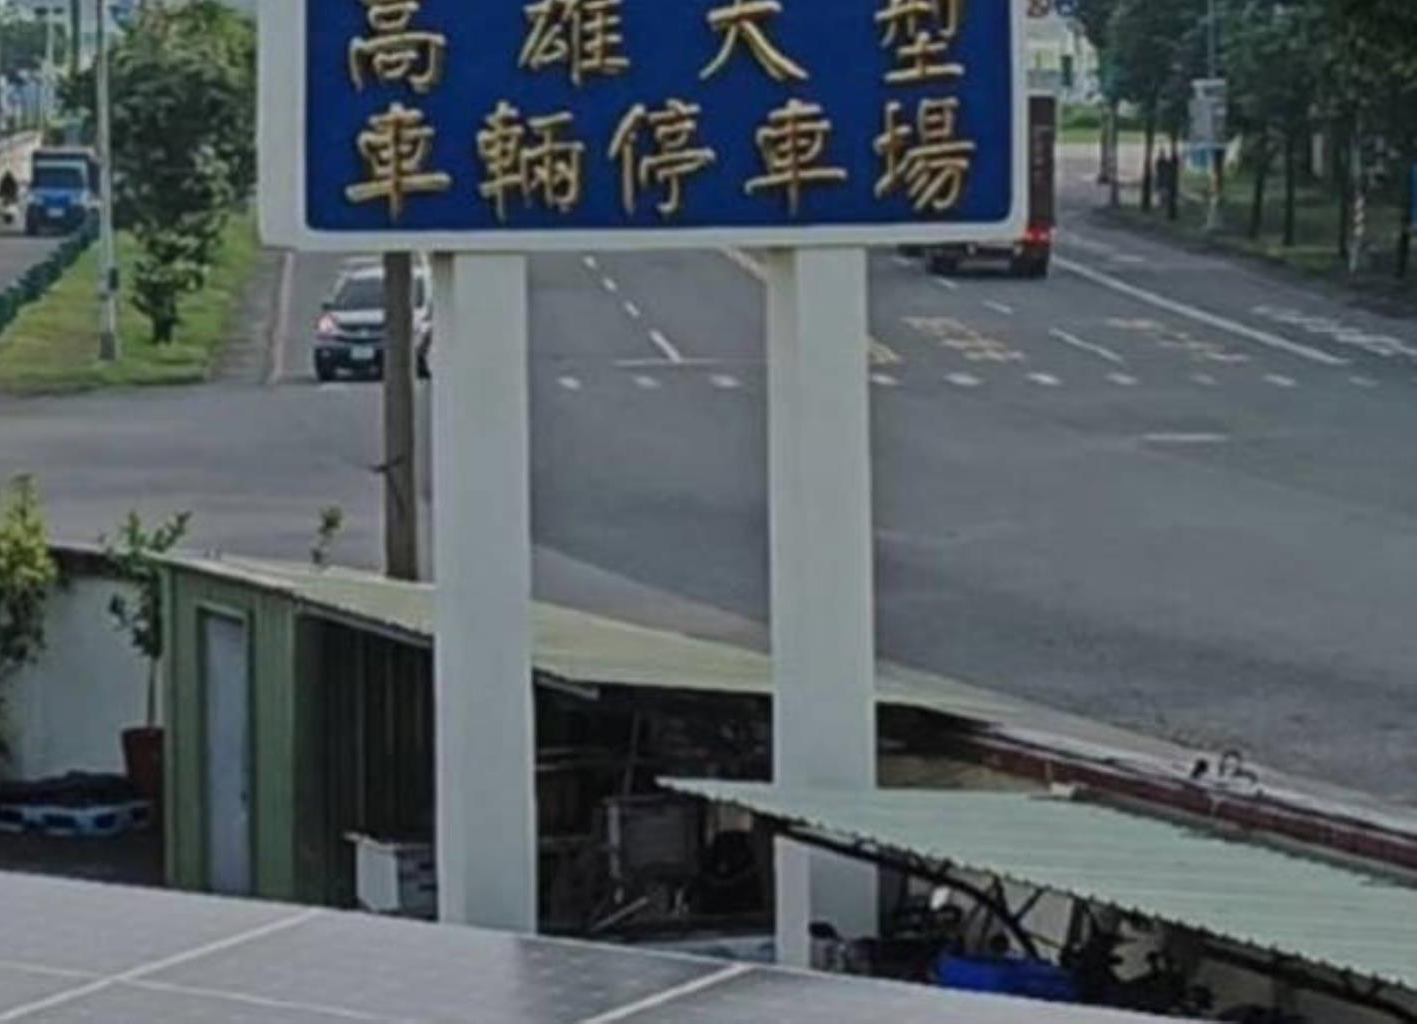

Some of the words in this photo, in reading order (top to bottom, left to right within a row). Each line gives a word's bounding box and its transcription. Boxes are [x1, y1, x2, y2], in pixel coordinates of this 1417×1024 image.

[346, 98, 976, 220] 車輛停車場
